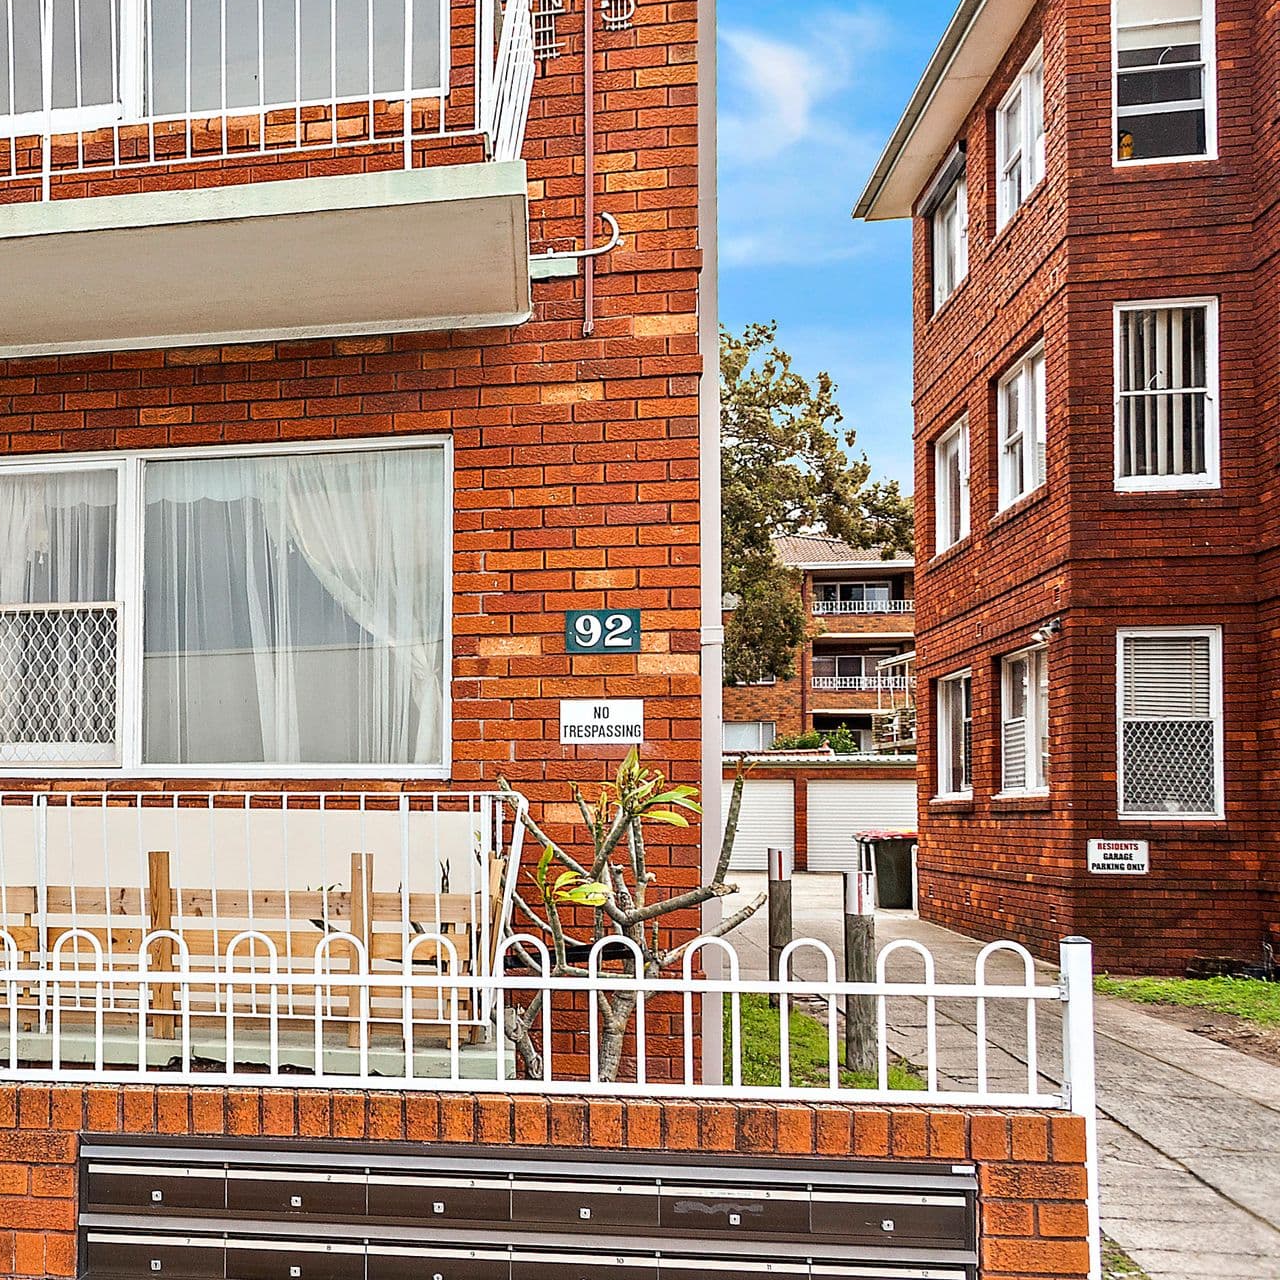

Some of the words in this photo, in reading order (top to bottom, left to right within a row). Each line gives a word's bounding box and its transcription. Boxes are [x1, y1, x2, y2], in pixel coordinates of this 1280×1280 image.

[574, 614, 633, 647] 92
[593, 706, 610, 719] NO
[563, 724, 641, 738] TRESPASSING
[1097, 842, 1139, 851] RESIDENTS
[1103, 852, 1133, 861] GARAGE
[1091, 862, 1125, 871] PARKING
[1126, 863, 1145, 871] ONLY
